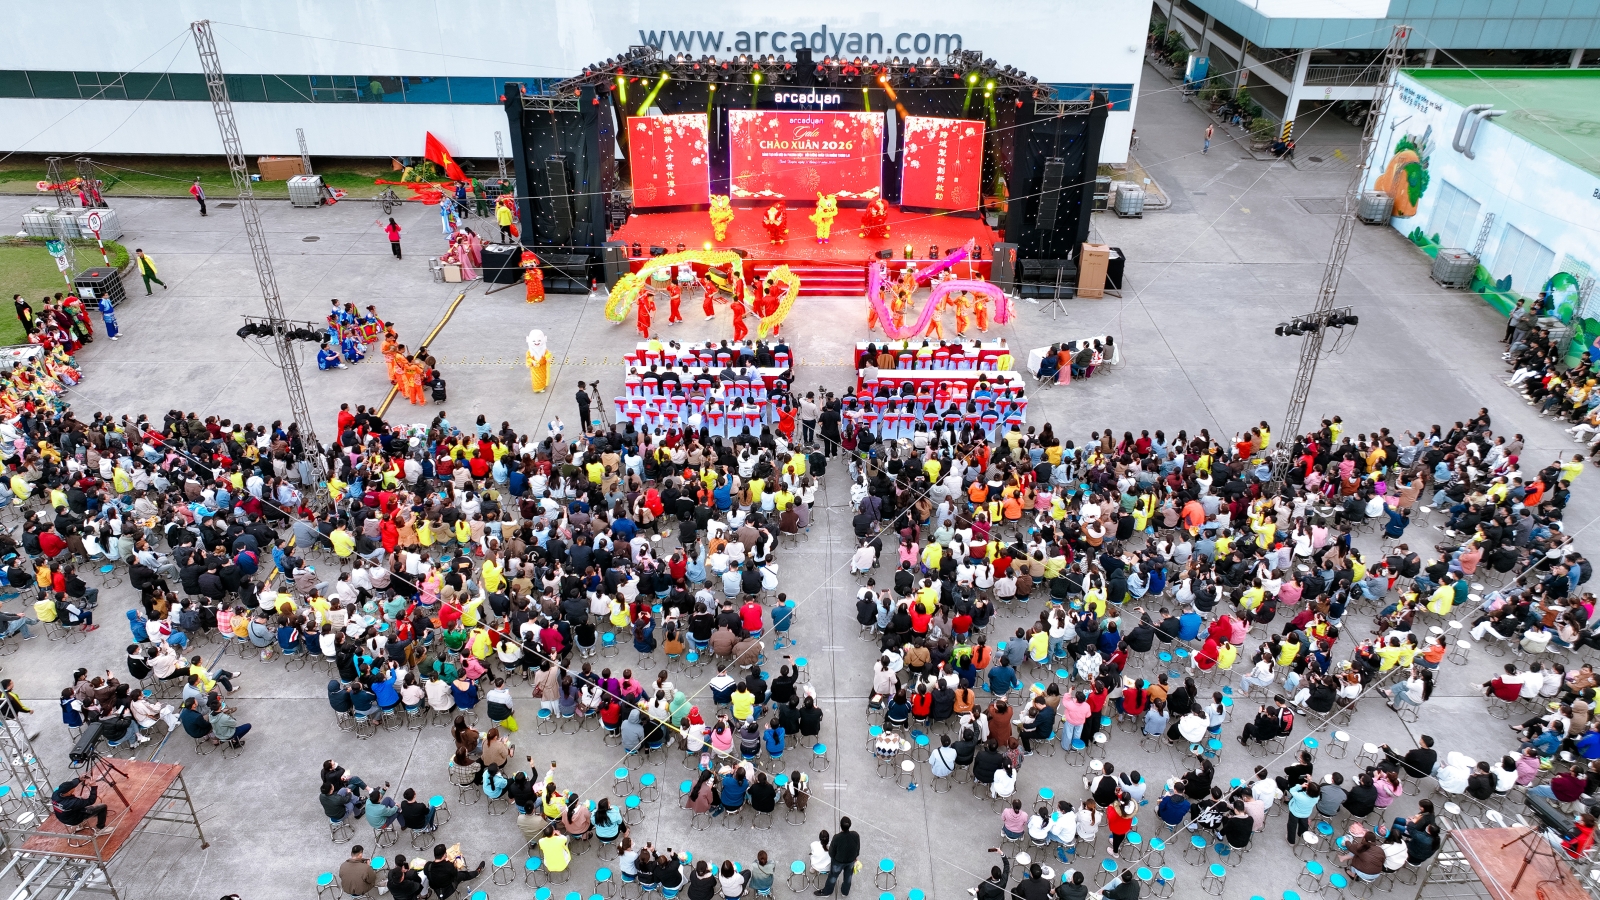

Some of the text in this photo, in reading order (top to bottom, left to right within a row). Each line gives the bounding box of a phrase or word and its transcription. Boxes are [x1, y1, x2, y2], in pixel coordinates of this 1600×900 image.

[638, 25, 964, 57] www.arcadyan.com
[774, 87, 841, 110] arcadyan
[789, 114, 824, 129] arcadyan
[792, 125, 820, 141] Gala
[760, 138, 853, 151] CHÀO XUÂN 2026
